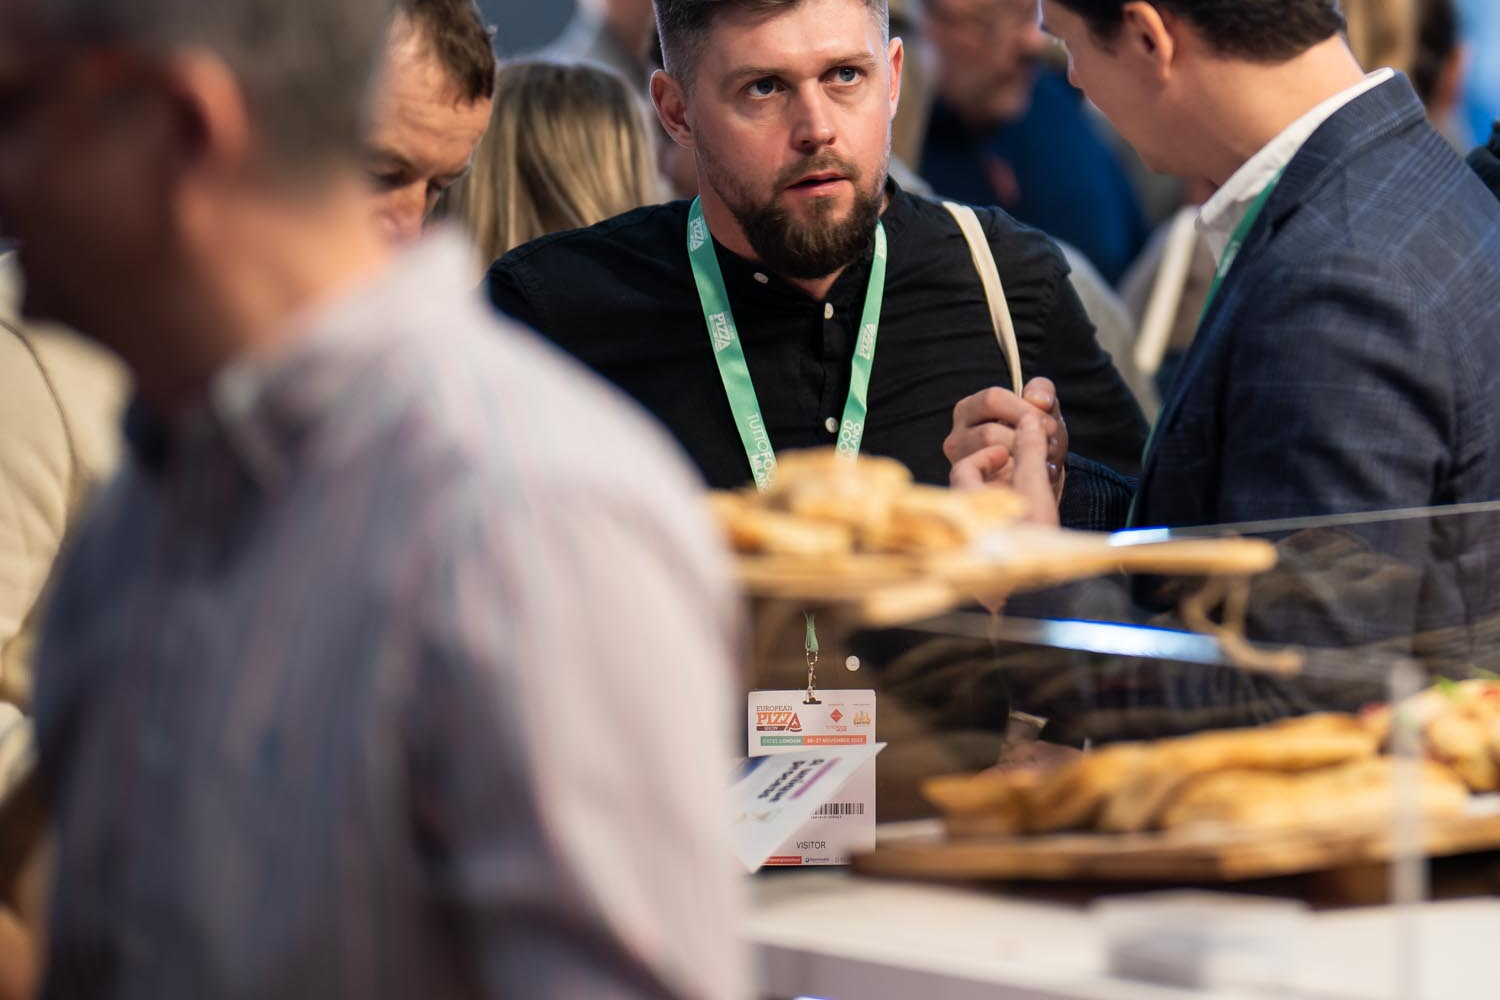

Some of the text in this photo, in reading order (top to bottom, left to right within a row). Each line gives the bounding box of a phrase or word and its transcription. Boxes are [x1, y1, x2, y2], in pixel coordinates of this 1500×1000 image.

[714, 312, 731, 352] PIZZA
[756, 712, 802, 732] PIZZA
[796, 841, 826, 849] VISITOR
